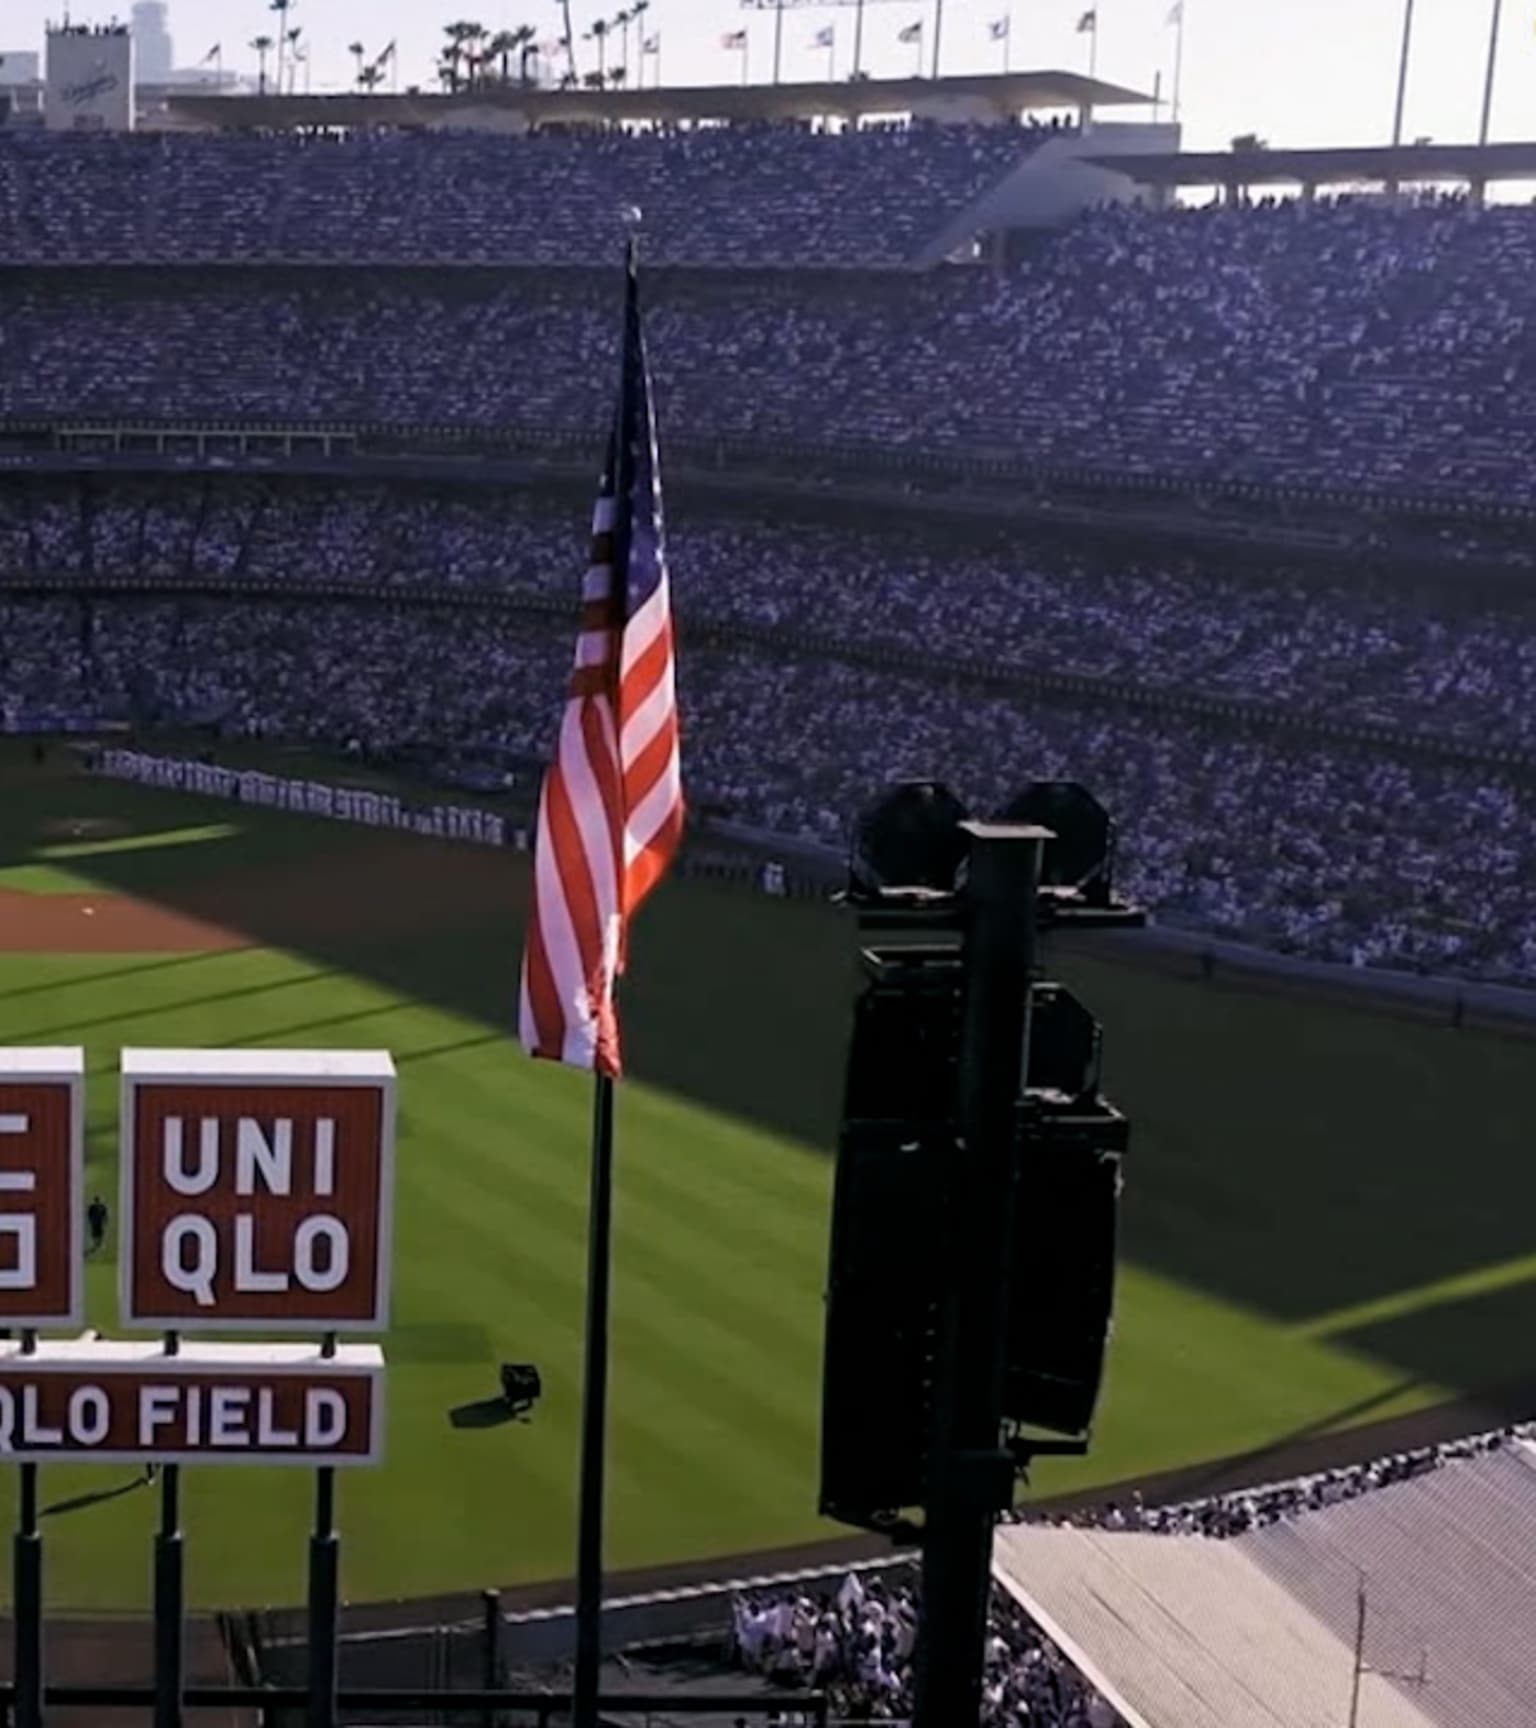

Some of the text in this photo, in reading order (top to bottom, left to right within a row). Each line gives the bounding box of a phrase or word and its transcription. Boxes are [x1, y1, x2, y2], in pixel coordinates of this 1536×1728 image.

[163, 1116, 335, 1196] UNI
[162, 1213, 349, 1306] QLO
[138, 1386, 346, 1446] FIELD
